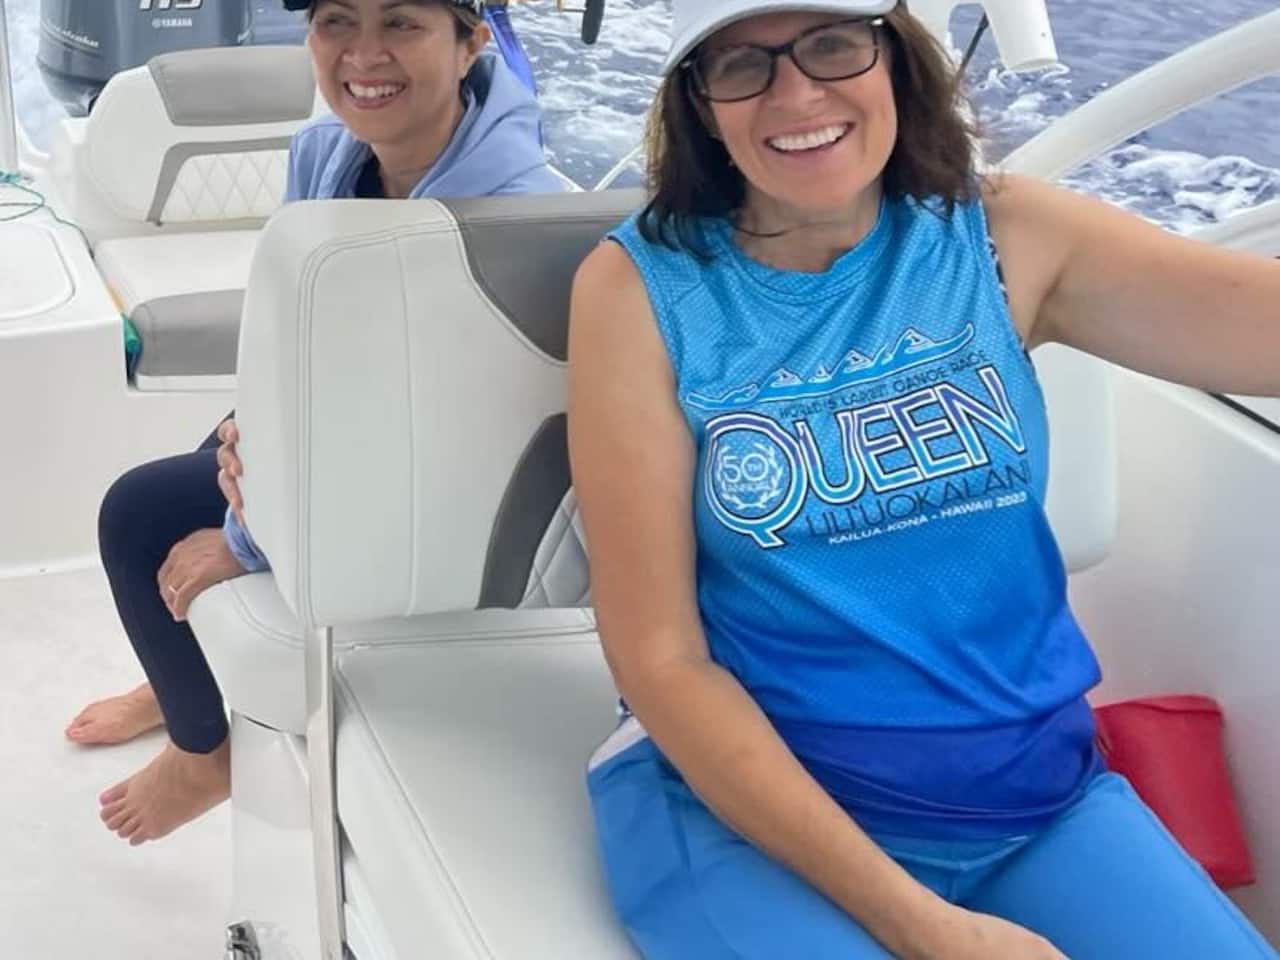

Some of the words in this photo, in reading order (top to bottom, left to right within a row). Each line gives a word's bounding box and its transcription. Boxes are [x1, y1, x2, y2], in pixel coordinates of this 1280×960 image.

[161, 17, 193, 28] YAMAHA
[894, 366, 949, 393] CANOE
[704, 365, 1026, 549] QUEEN
[723, 452, 769, 482] 50
